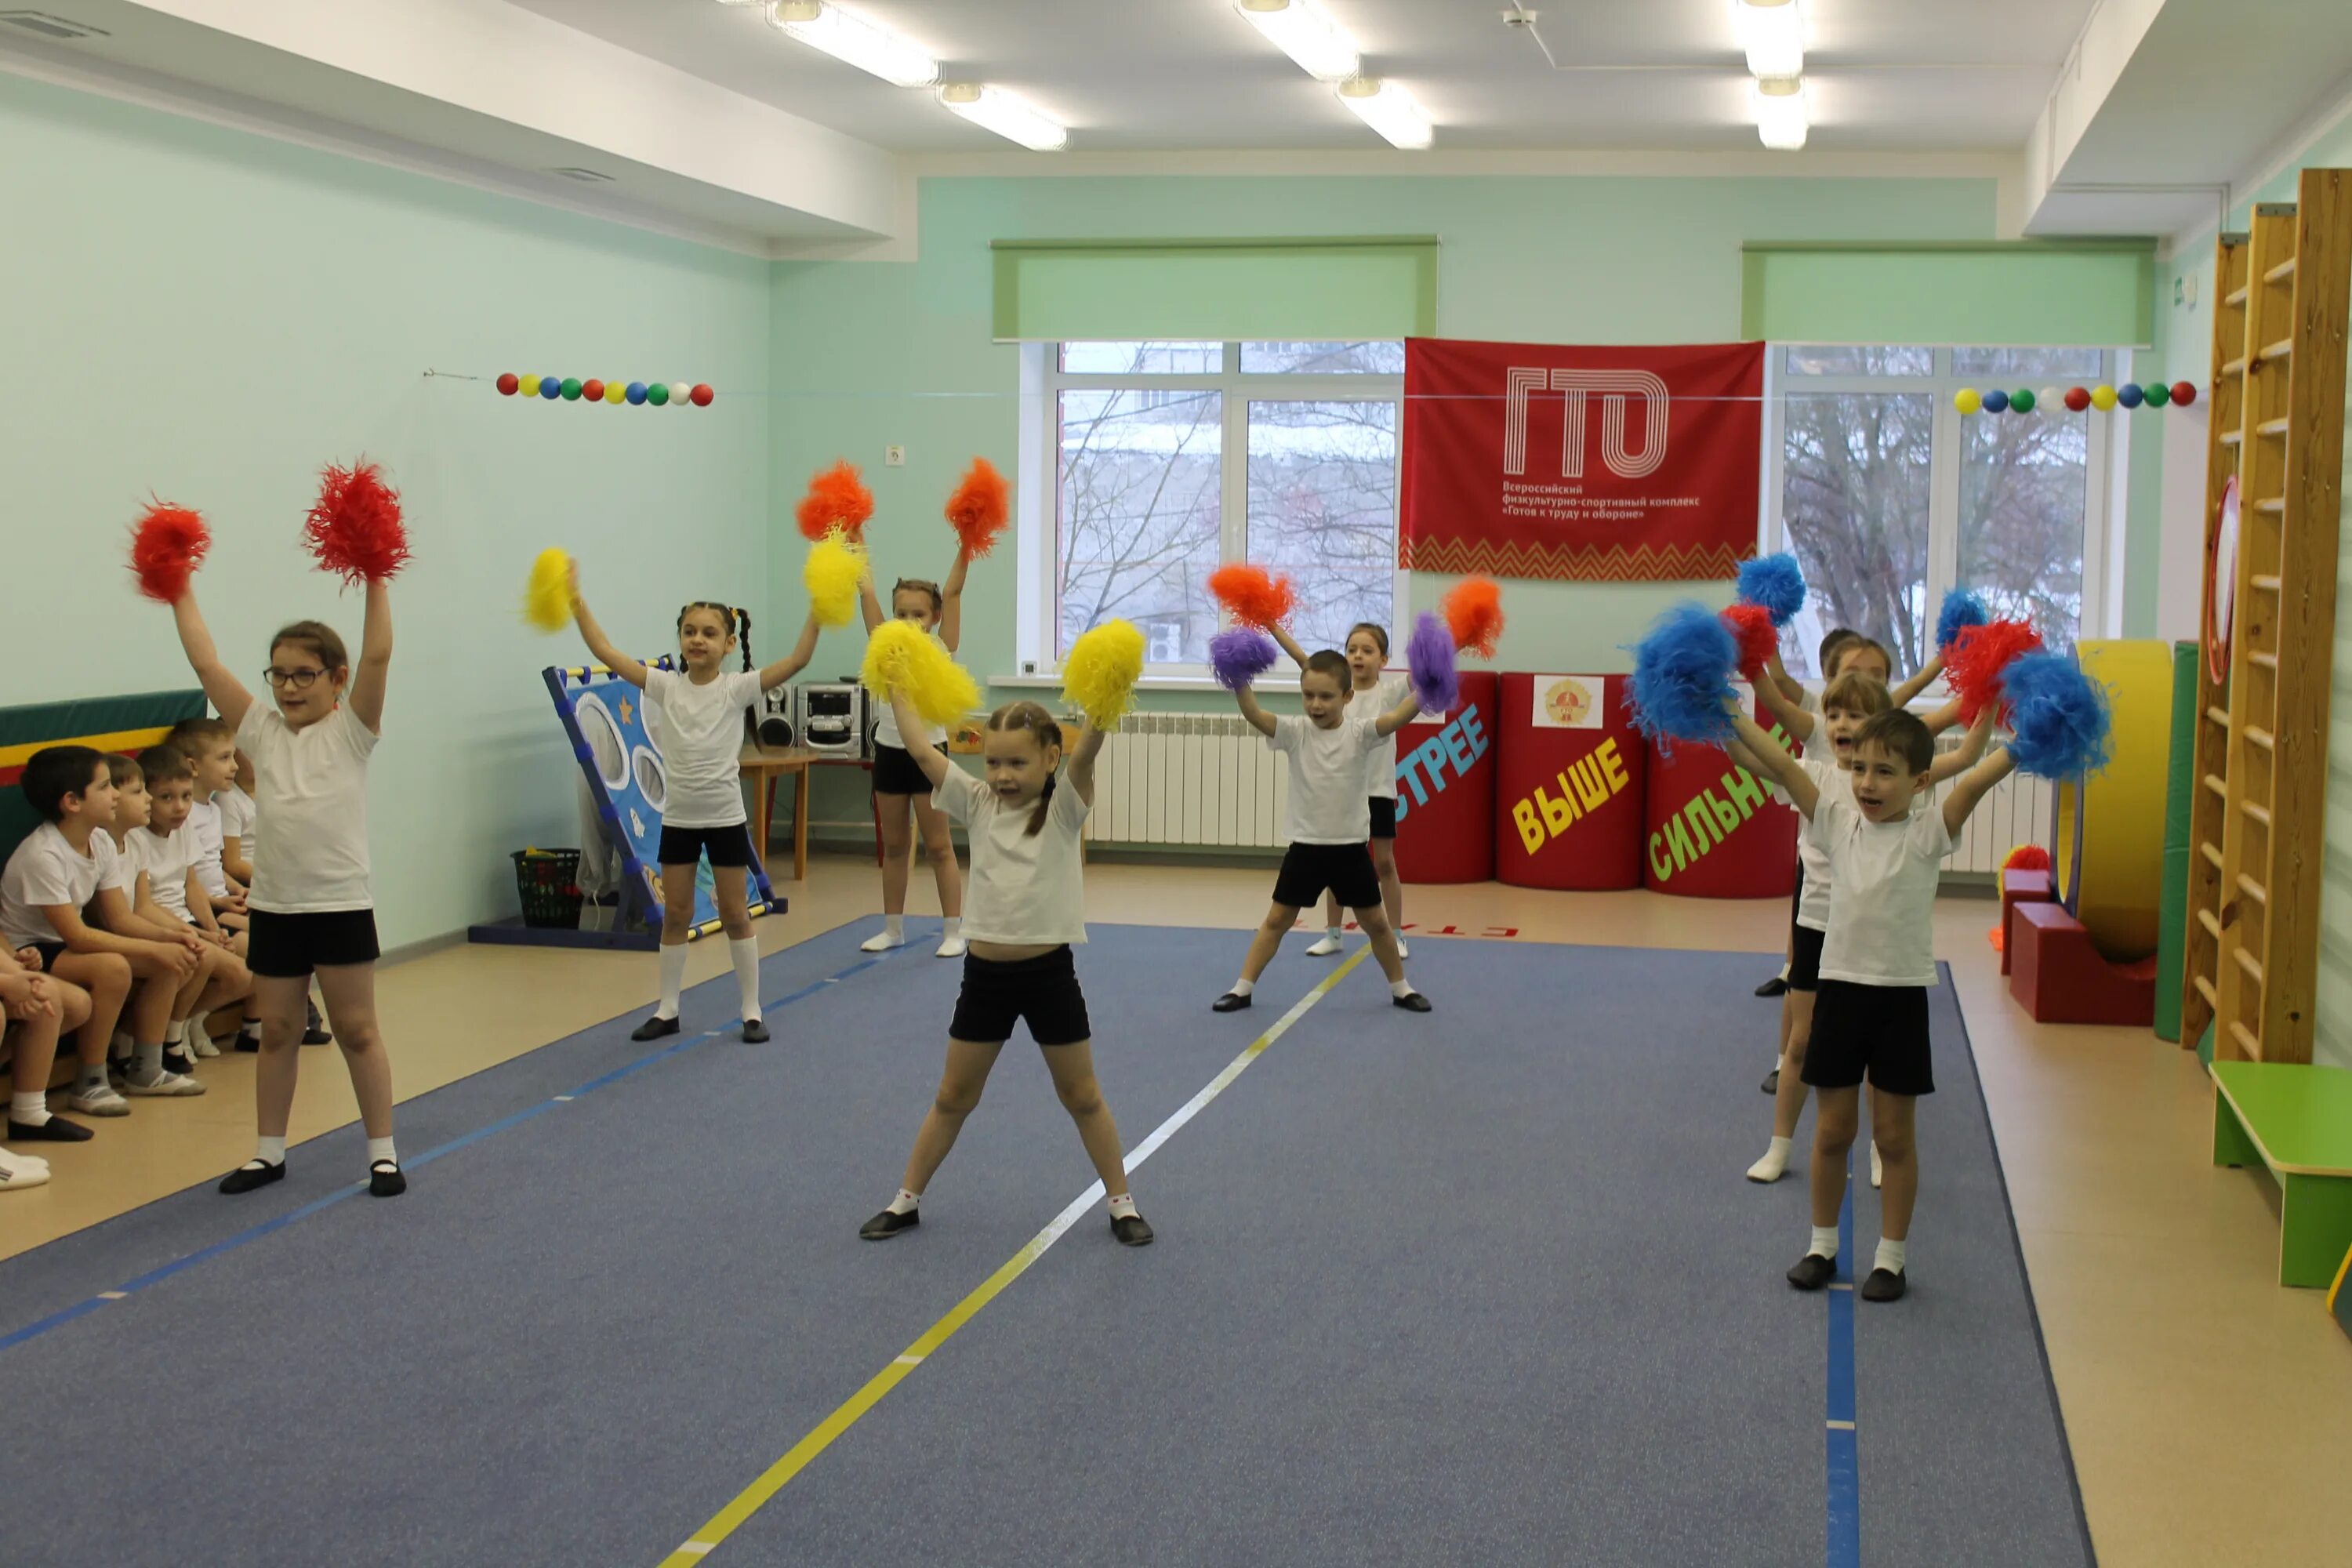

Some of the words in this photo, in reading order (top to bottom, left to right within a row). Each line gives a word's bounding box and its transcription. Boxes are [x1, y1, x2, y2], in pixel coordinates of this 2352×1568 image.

[1504, 367, 1669, 478] ГТО
[1502, 493, 1646, 509] физкультурно-спортивный
[1650, 496, 1700, 506] комплекс
[1502, 504, 1537, 517] «Готов
[1540, 509, 1545, 517] к
[1549, 508, 1580, 521] труду
[1583, 510, 1588, 518] и
[1592, 508, 1644, 521] обороне»
[1503, 481, 1582, 495] Всероссийский
[1512, 736, 1630, 855] ВЫШЕ
[1650, 722, 1795, 881] СИЛЬНЕ
